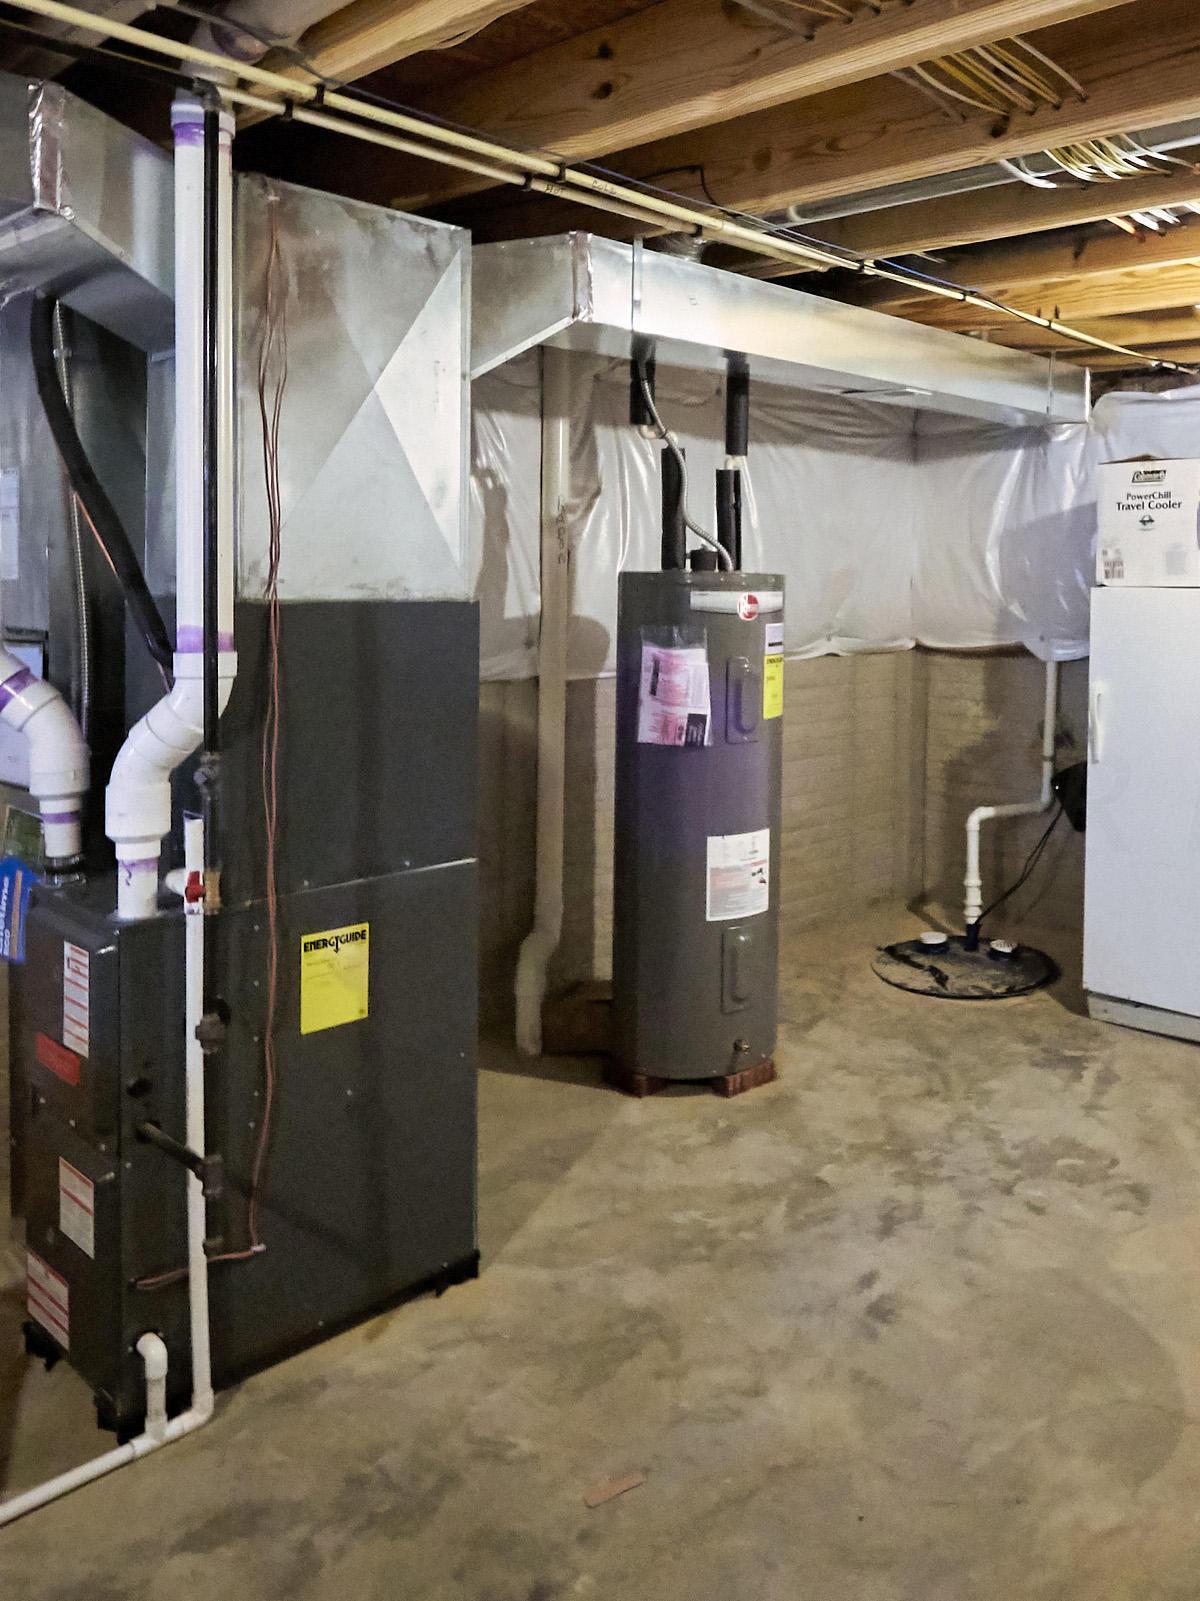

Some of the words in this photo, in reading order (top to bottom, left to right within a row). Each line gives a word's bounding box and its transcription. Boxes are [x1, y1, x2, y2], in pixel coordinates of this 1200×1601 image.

[1127, 491, 1171, 500] PowerChill
[1117, 501, 1145, 511] Travel
[1148, 500, 1181, 510] Cooler
